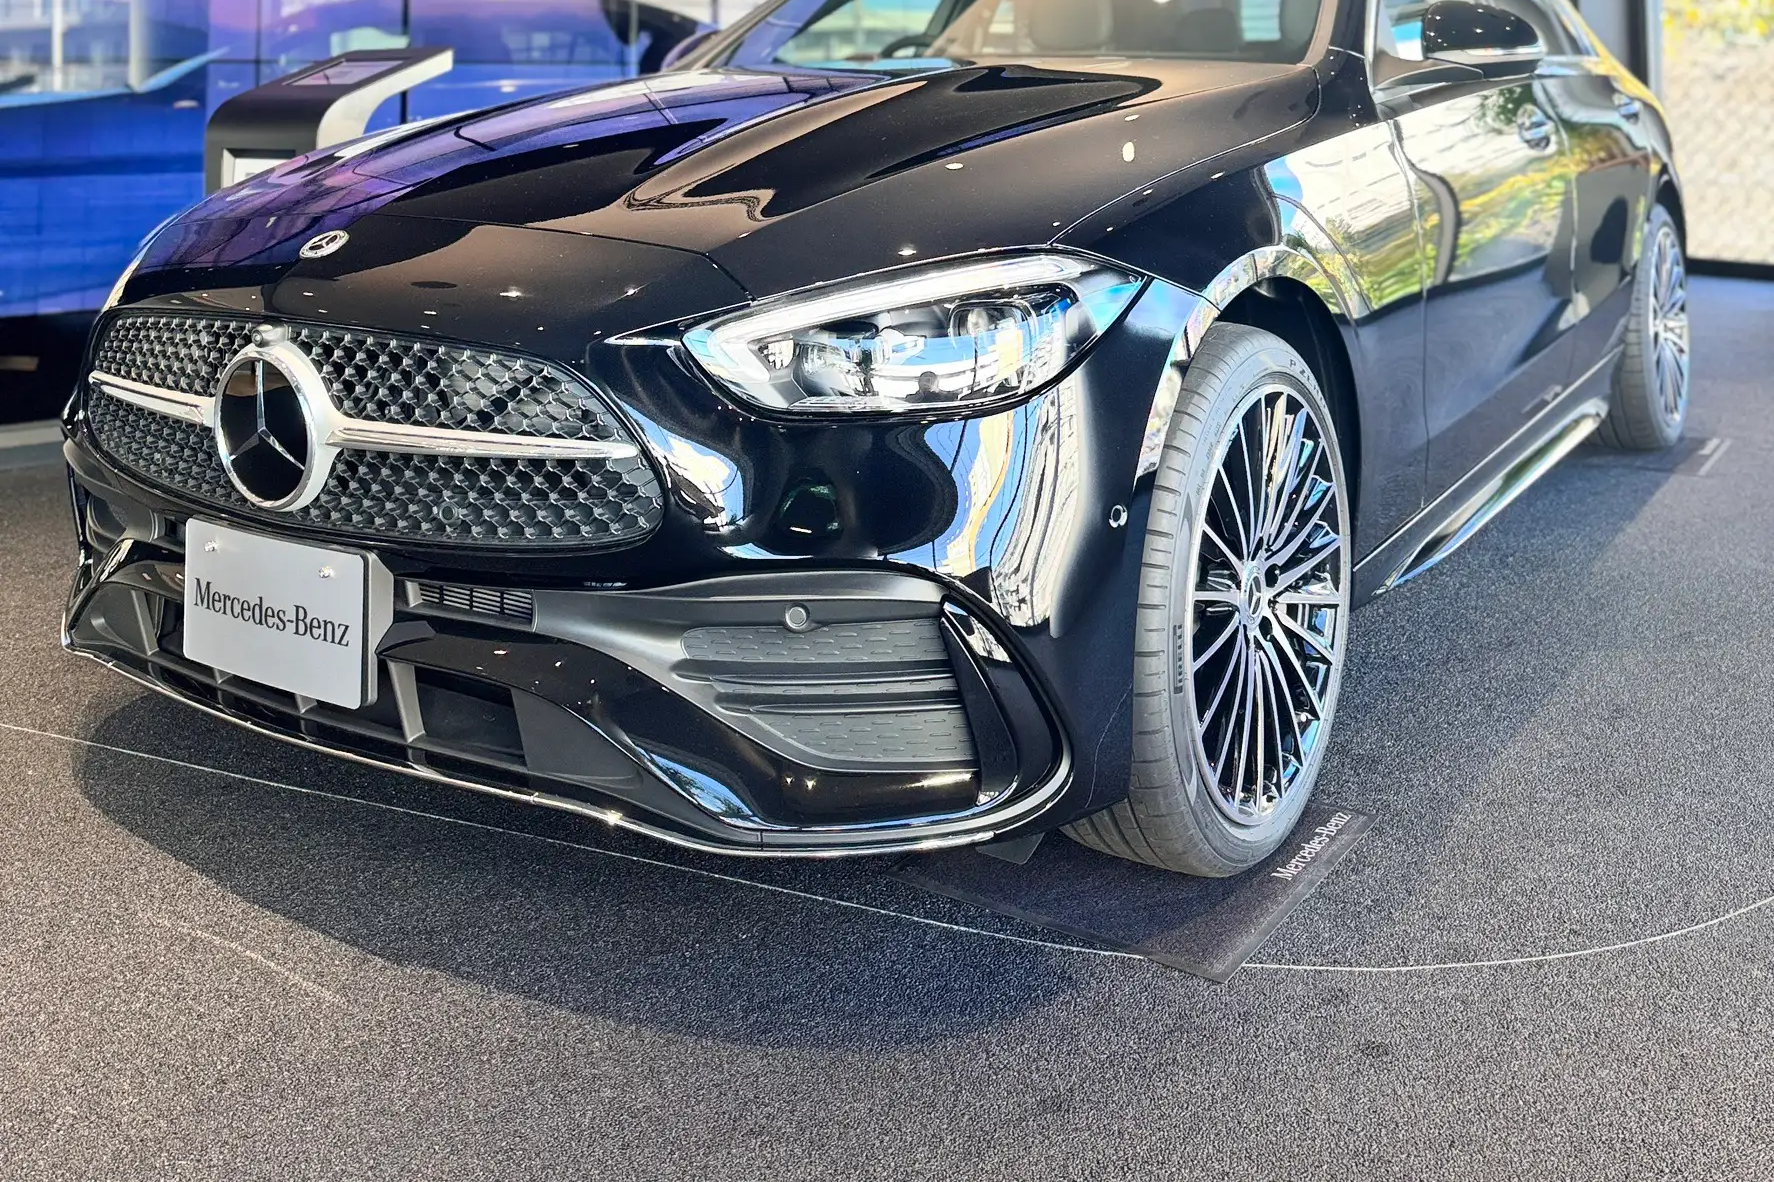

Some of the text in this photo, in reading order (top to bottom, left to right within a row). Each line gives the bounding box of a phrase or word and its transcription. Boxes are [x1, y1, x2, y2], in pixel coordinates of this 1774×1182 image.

[194, 577, 350, 647] Mercedes-Benz
[1173, 624, 1183, 694] PIRELLI
[1270, 811, 1352, 881] Mercedes-Benz
